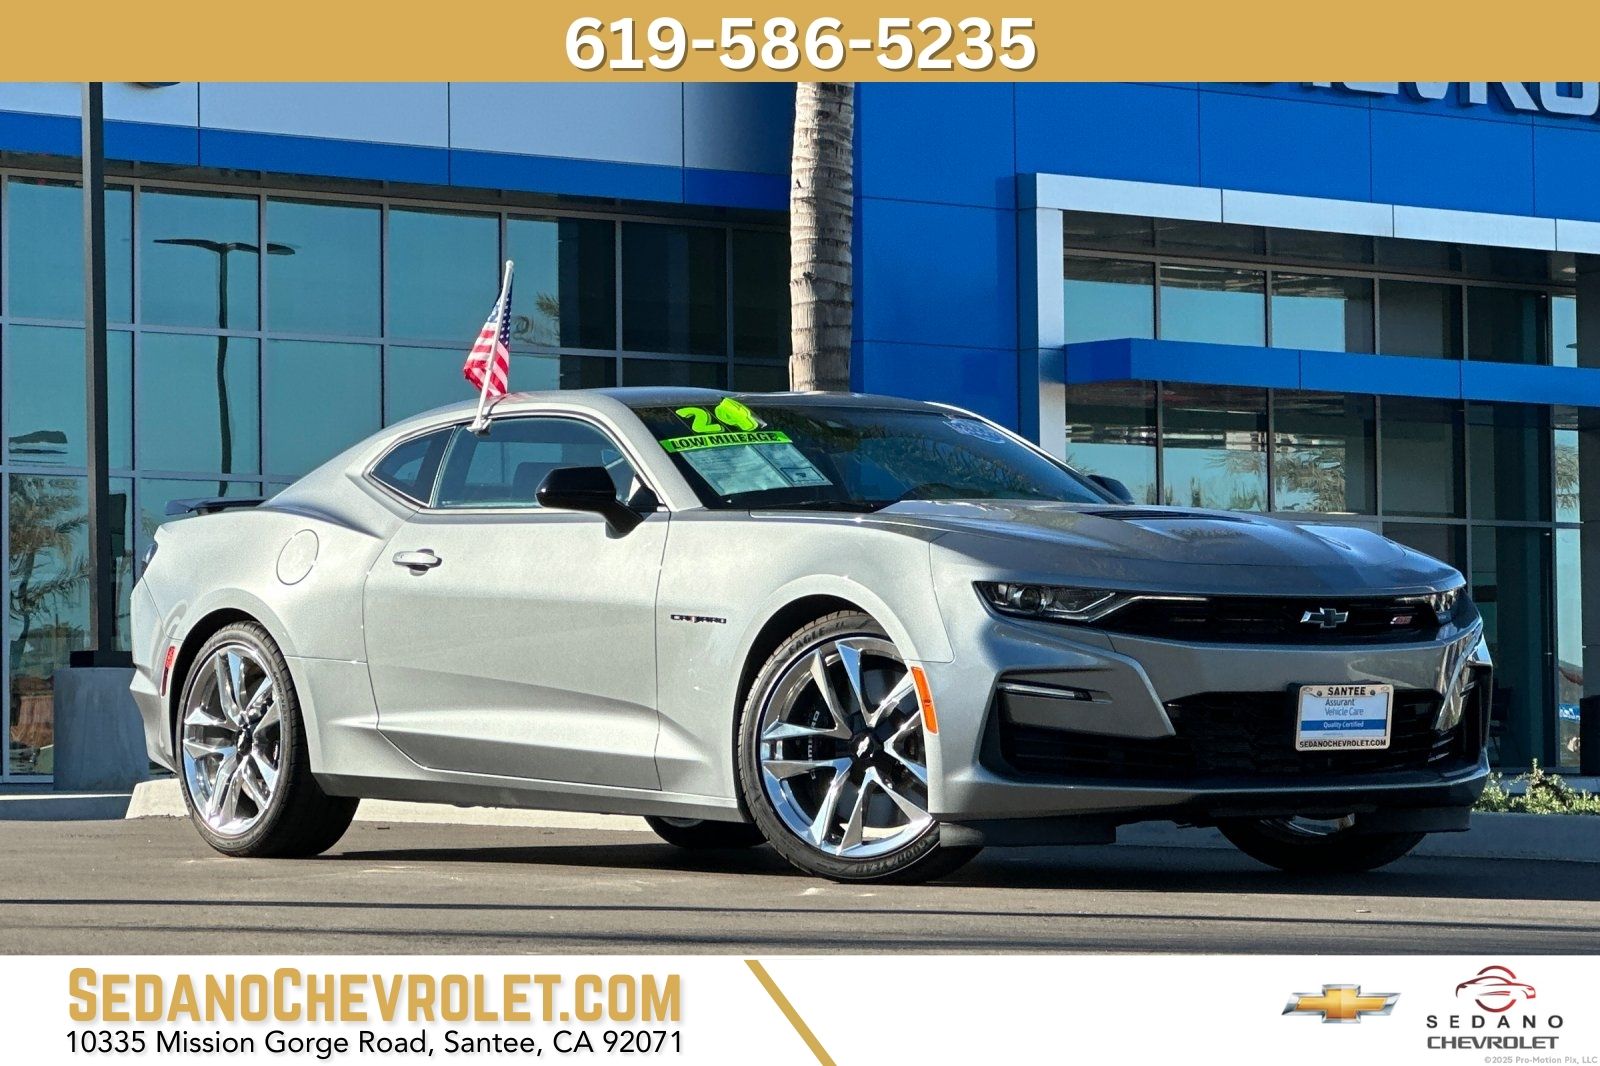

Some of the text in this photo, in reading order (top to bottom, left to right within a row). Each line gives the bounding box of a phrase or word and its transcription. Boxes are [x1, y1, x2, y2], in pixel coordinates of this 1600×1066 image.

[672, 433, 778, 449] LOW MILEAGE
[1327, 686, 1367, 696] SANTEE
[1325, 698, 1355, 707] Assurant
[1324, 707, 1365, 716] Vehicle Care
[1323, 721, 1341, 729] Quality
[1300, 739, 1387, 748] SEDANOCHEVROLET.COM
